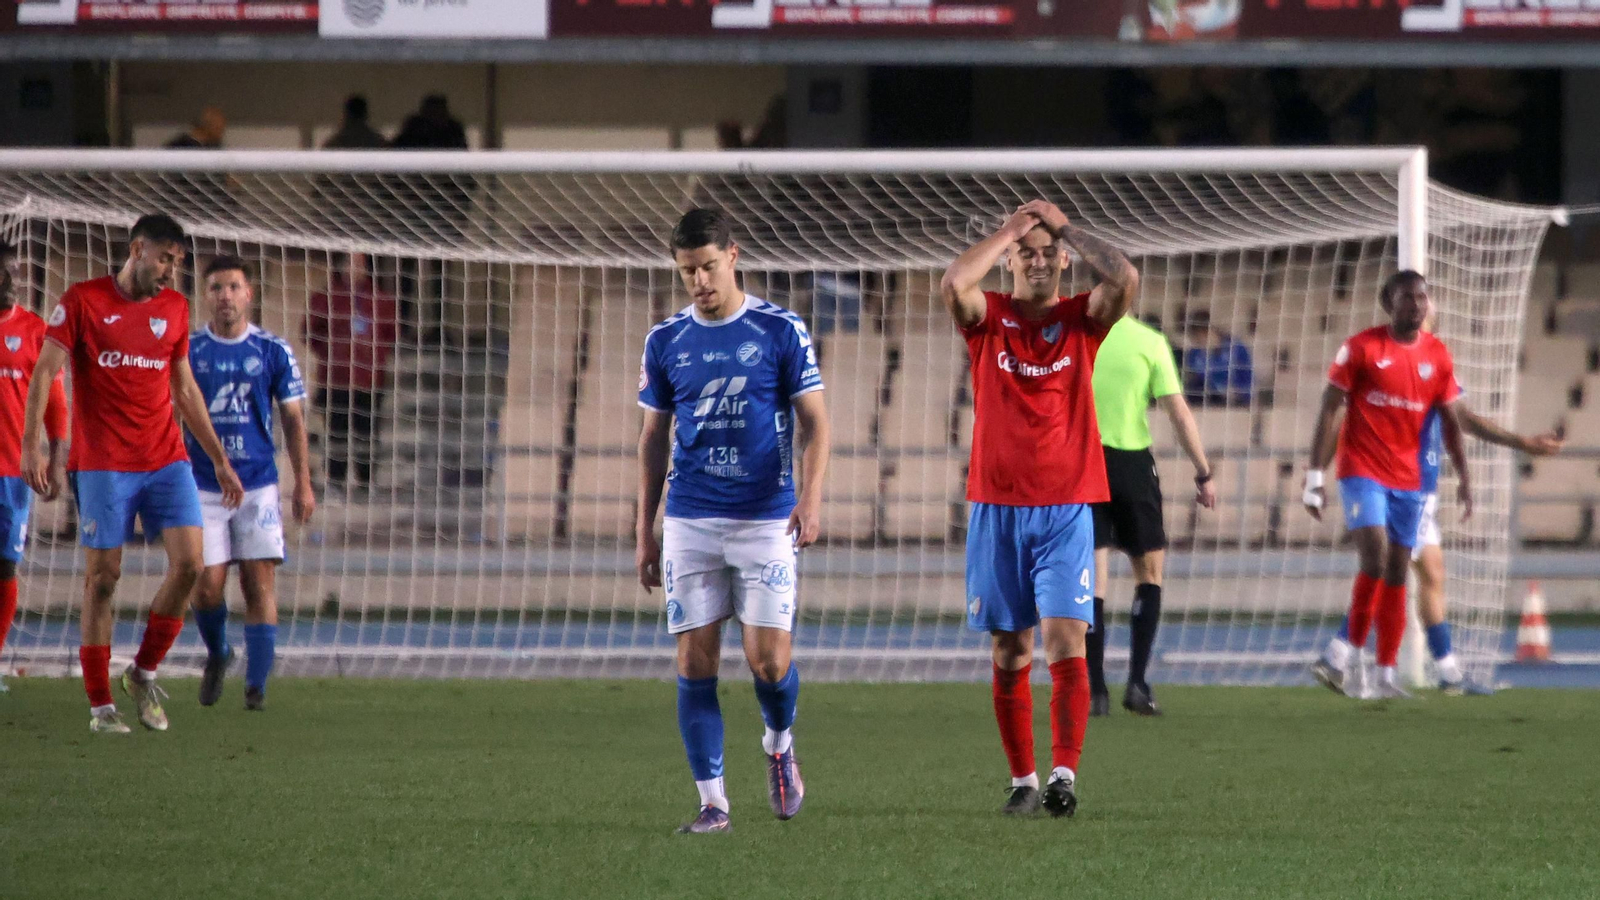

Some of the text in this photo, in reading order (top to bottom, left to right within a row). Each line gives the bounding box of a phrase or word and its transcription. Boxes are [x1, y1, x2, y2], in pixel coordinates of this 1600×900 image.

[121, 353, 167, 371] AirEurop
[717, 398, 748, 416] Air
[1079, 568, 1090, 590] 4
